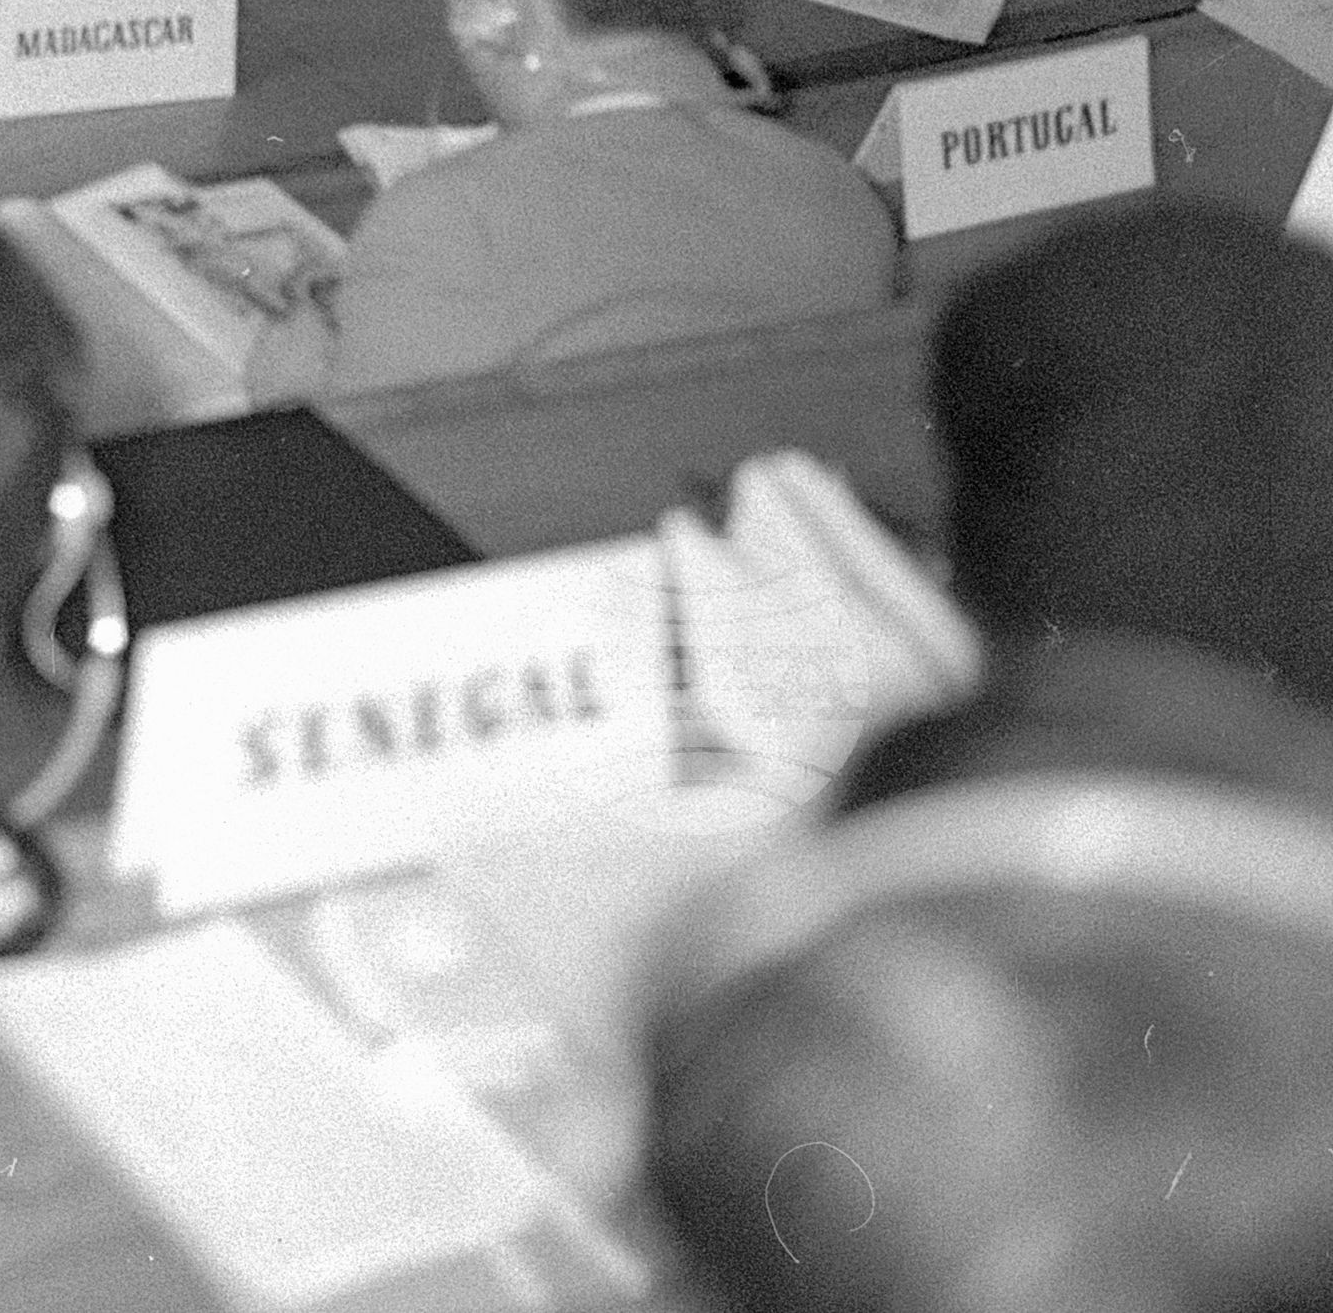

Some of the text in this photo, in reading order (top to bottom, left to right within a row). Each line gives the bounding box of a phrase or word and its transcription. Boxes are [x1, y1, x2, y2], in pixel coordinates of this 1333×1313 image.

[16, 14, 194, 59] MADAGASCAR
[941, 99, 1118, 170] PORTUGAL
[239, 646, 606, 791] SENEGAL
